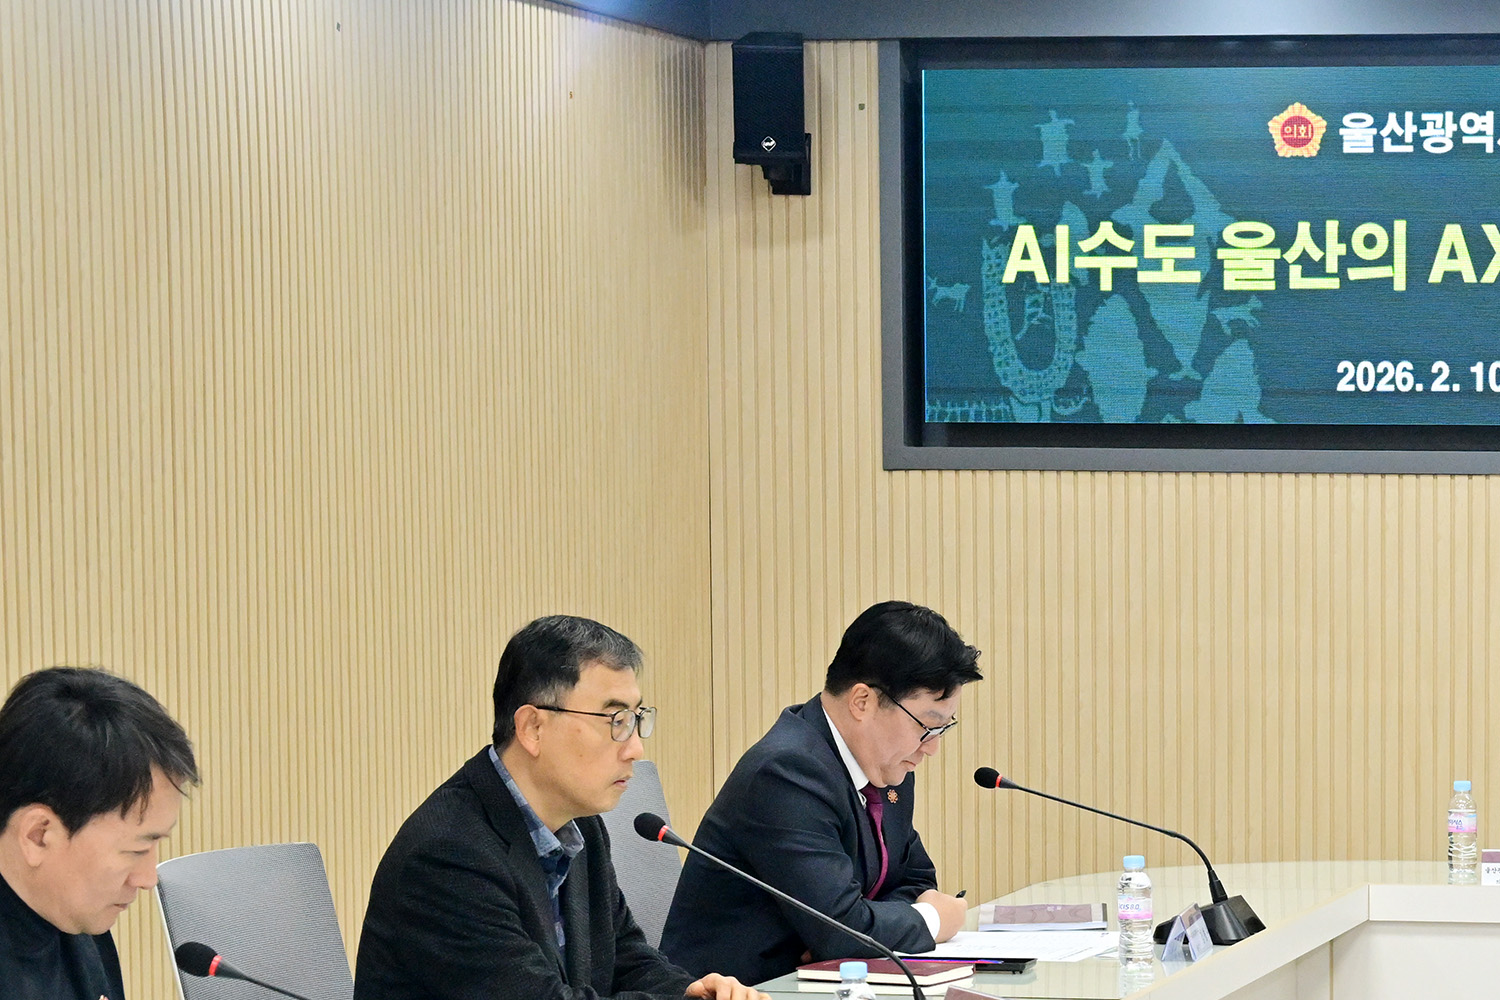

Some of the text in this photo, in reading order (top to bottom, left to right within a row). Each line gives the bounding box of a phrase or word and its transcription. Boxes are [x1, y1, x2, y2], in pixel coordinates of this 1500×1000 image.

[1283, 124, 1313, 139] 의회
[1003, 222, 1201, 291] AI수도
[1217, 220, 1407, 291] 울산의
[1337, 361, 1420, 392] 2026.
[1431, 361, 1461, 392] 2.
